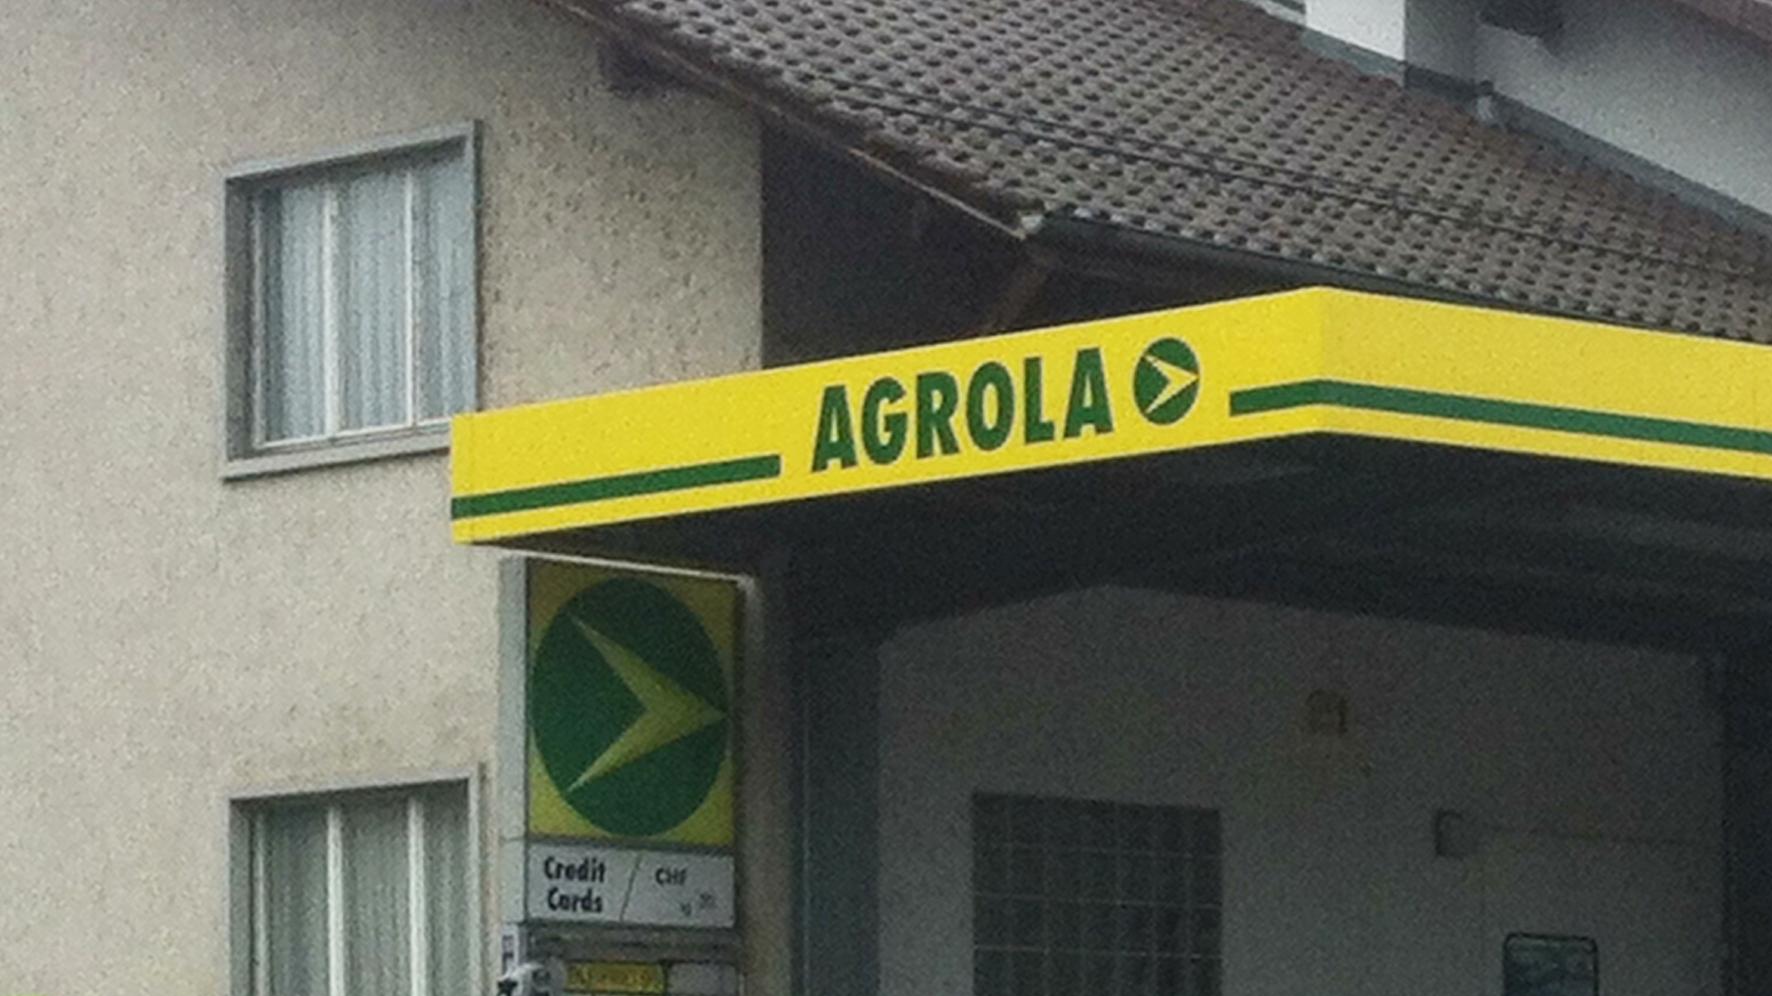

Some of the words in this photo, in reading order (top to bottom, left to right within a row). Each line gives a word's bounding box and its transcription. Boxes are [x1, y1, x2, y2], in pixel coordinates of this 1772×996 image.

[811, 346, 1114, 473] AGROLA
[543, 856, 606, 884] Credit
[547, 886, 603, 913] Cards
